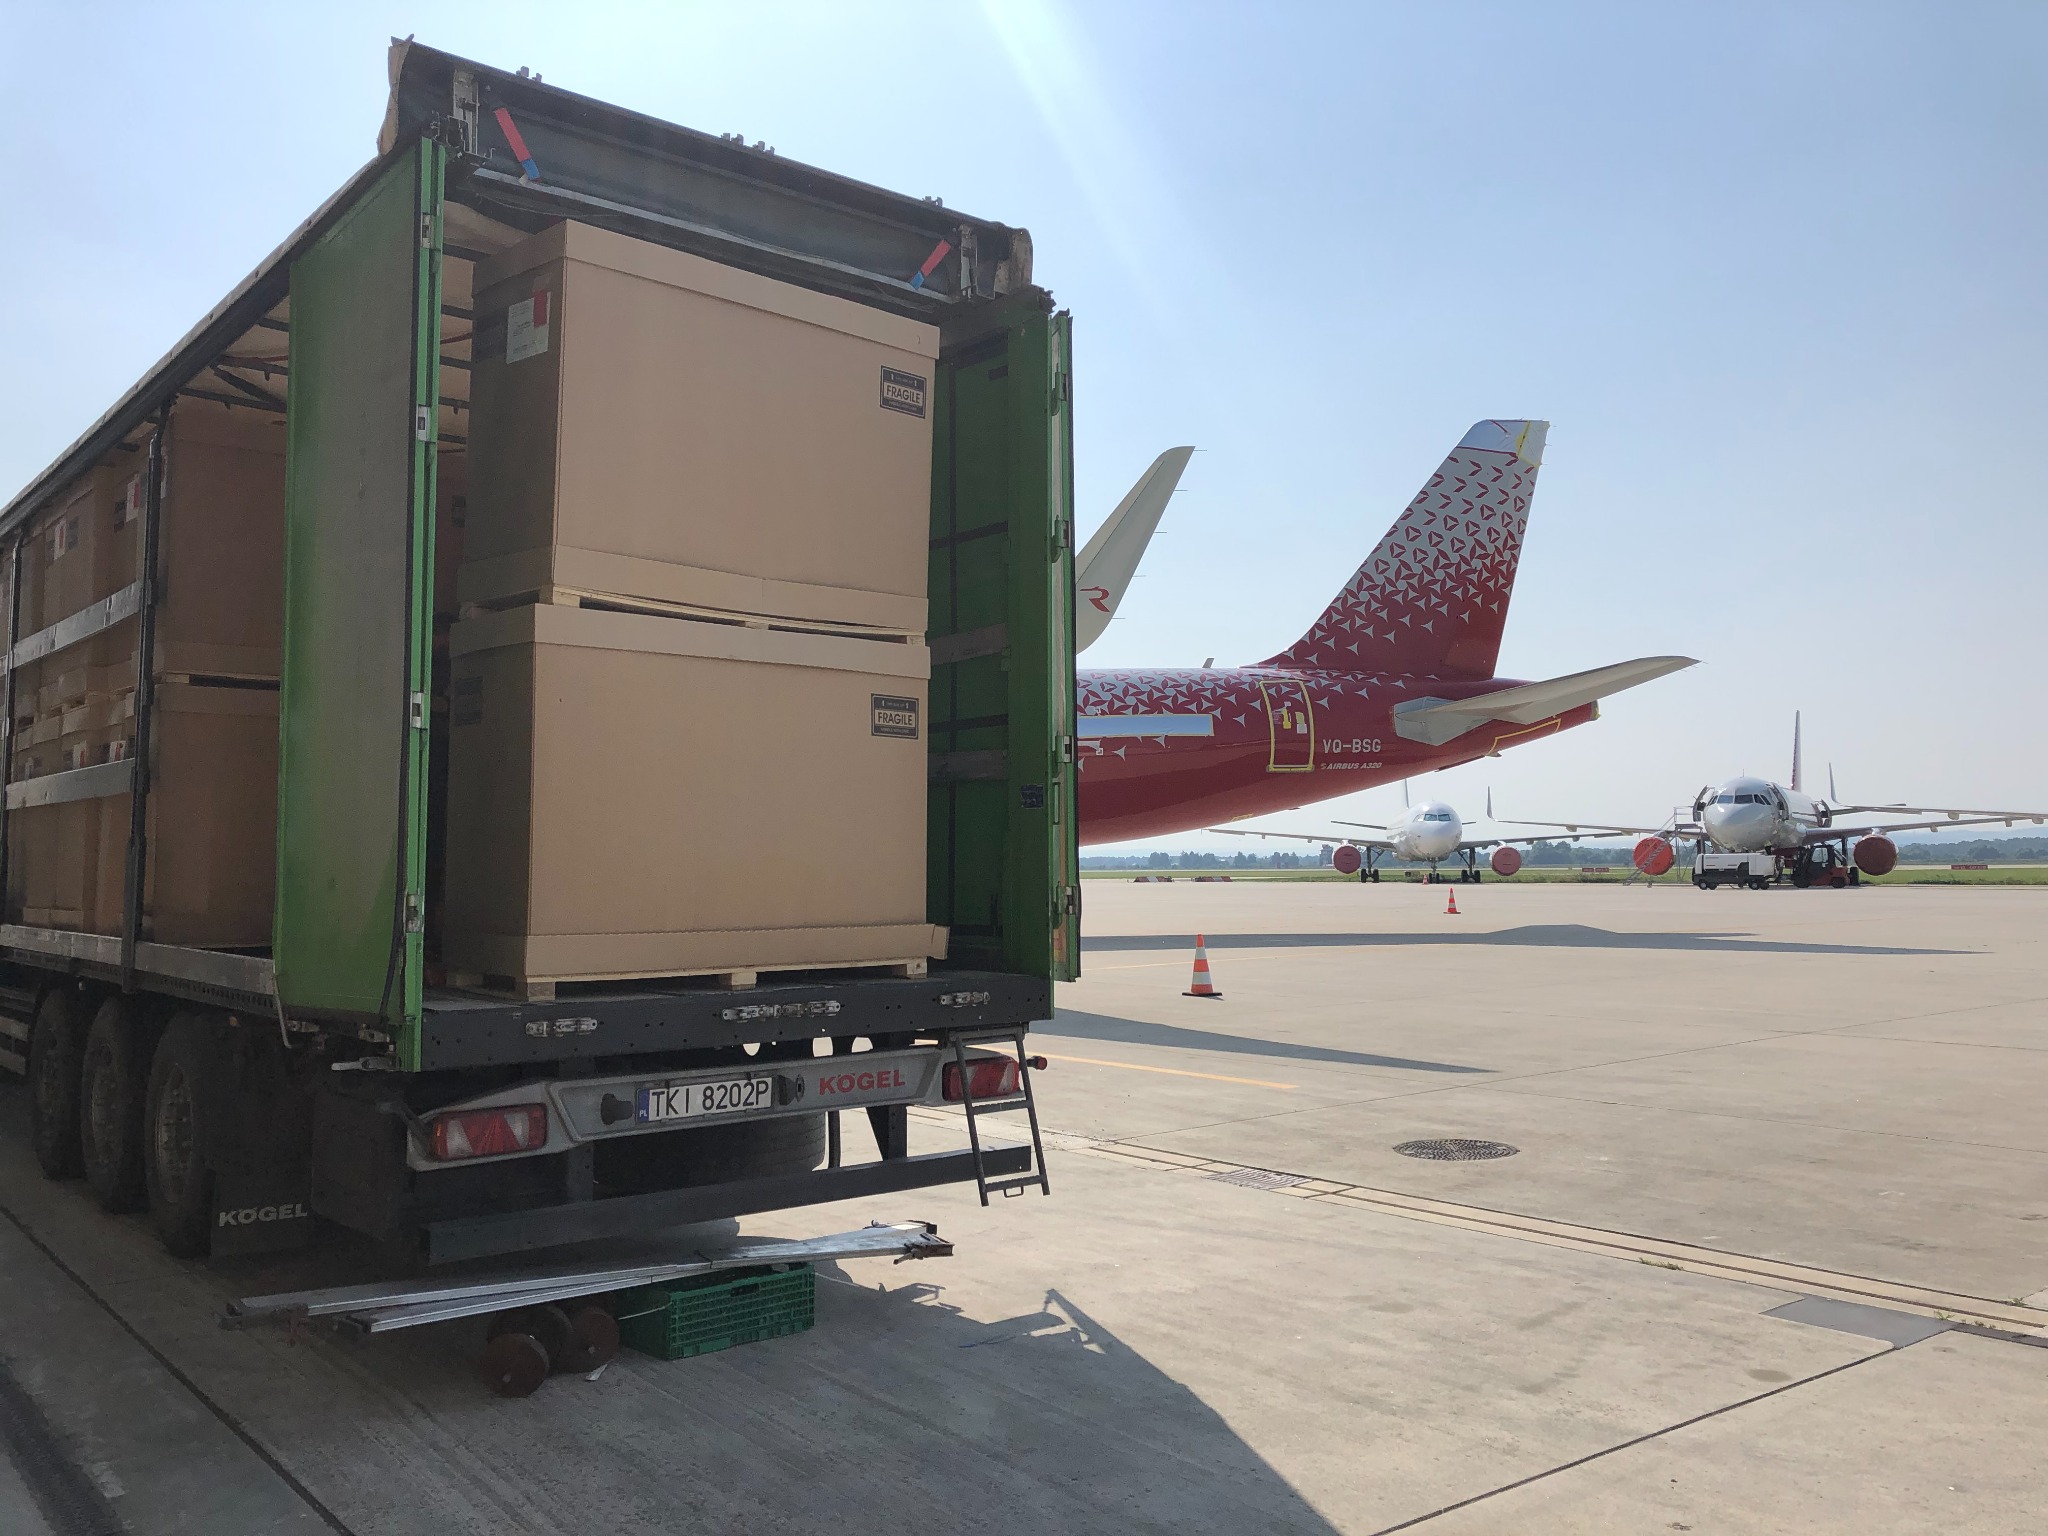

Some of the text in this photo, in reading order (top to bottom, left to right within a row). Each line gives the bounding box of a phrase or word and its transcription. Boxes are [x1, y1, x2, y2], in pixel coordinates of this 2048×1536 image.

[886, 385, 921, 404] FRAGILE
[877, 711, 913, 726] FRAGILE
[1322, 738, 1382, 754] VQ-BSG
[1326, 762, 1383, 770] AIRBUS A320
[818, 1069, 906, 1096] KÖGEL
[651, 1080, 769, 1118] TKI 8202P
[639, 1109, 648, 1118] PL
